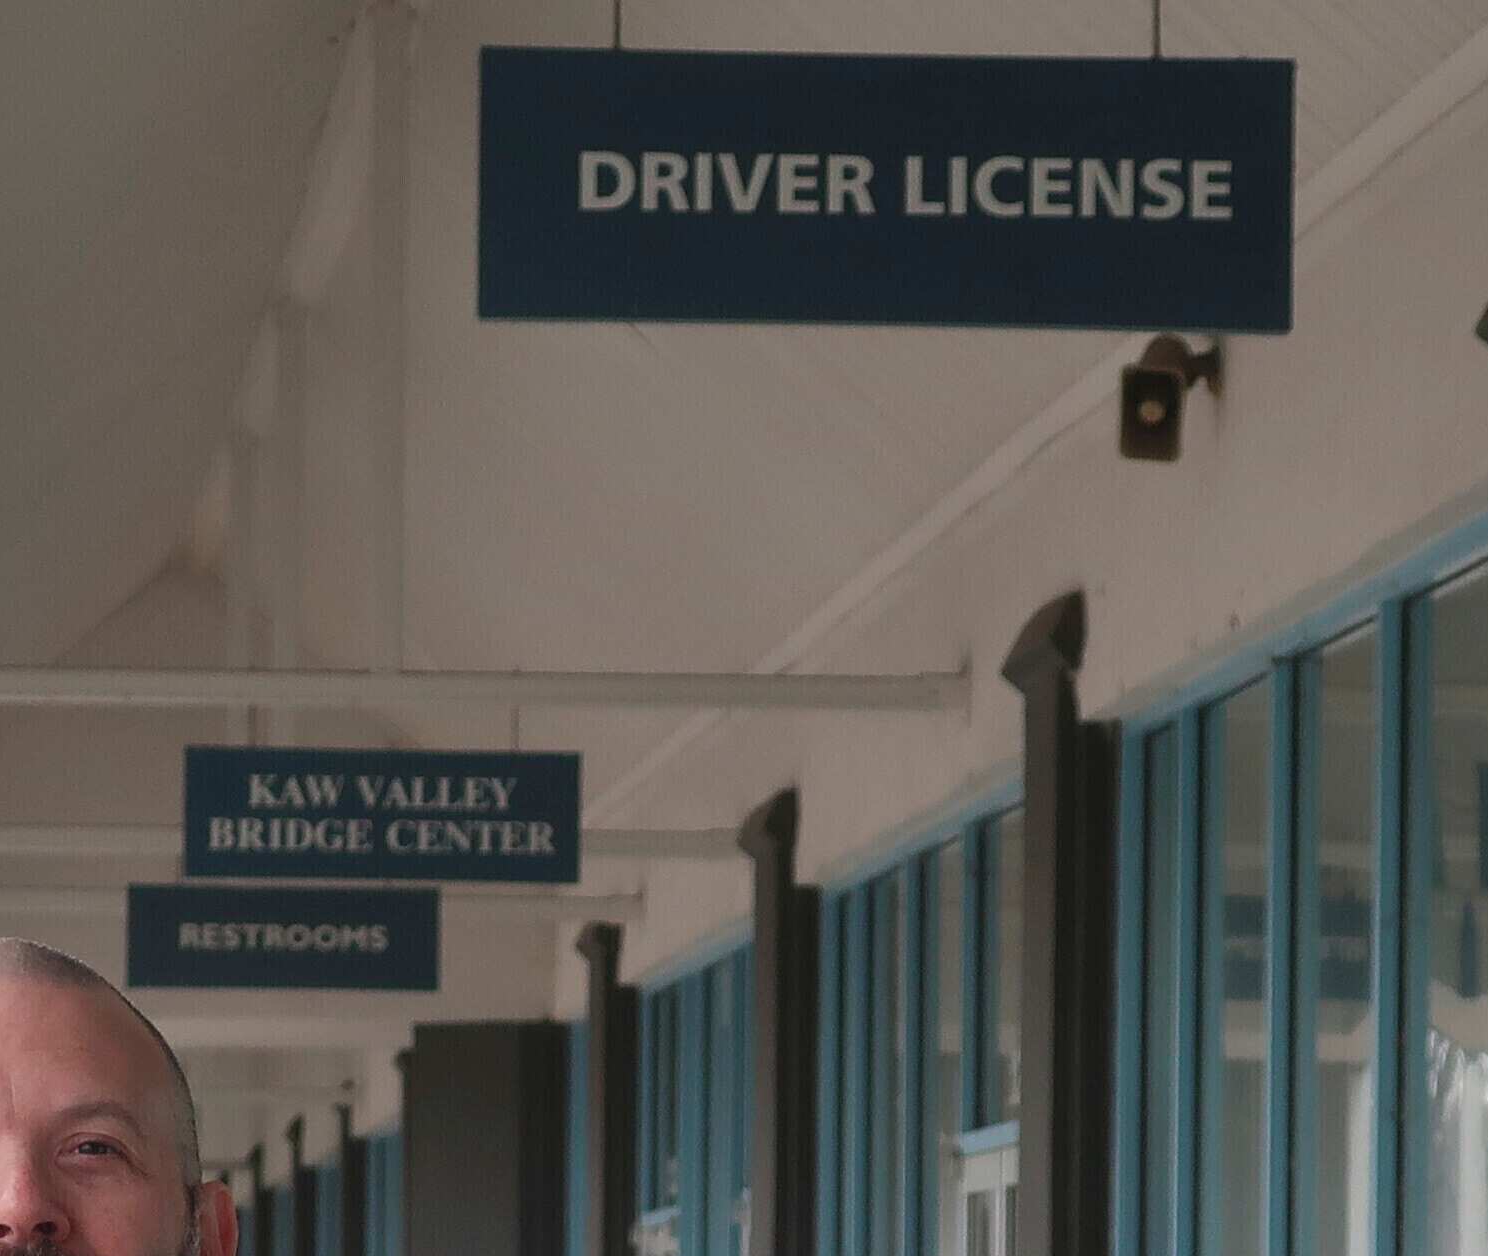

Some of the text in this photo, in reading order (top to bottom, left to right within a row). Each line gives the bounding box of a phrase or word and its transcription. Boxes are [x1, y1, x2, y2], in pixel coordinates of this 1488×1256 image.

[577, 150, 1234, 222] DRIVER LICENSE
[248, 773, 518, 812] KAW VALLEY
[209, 817, 557, 857] BRIDGE CENTER
[177, 921, 390, 954] RESTROOMS
